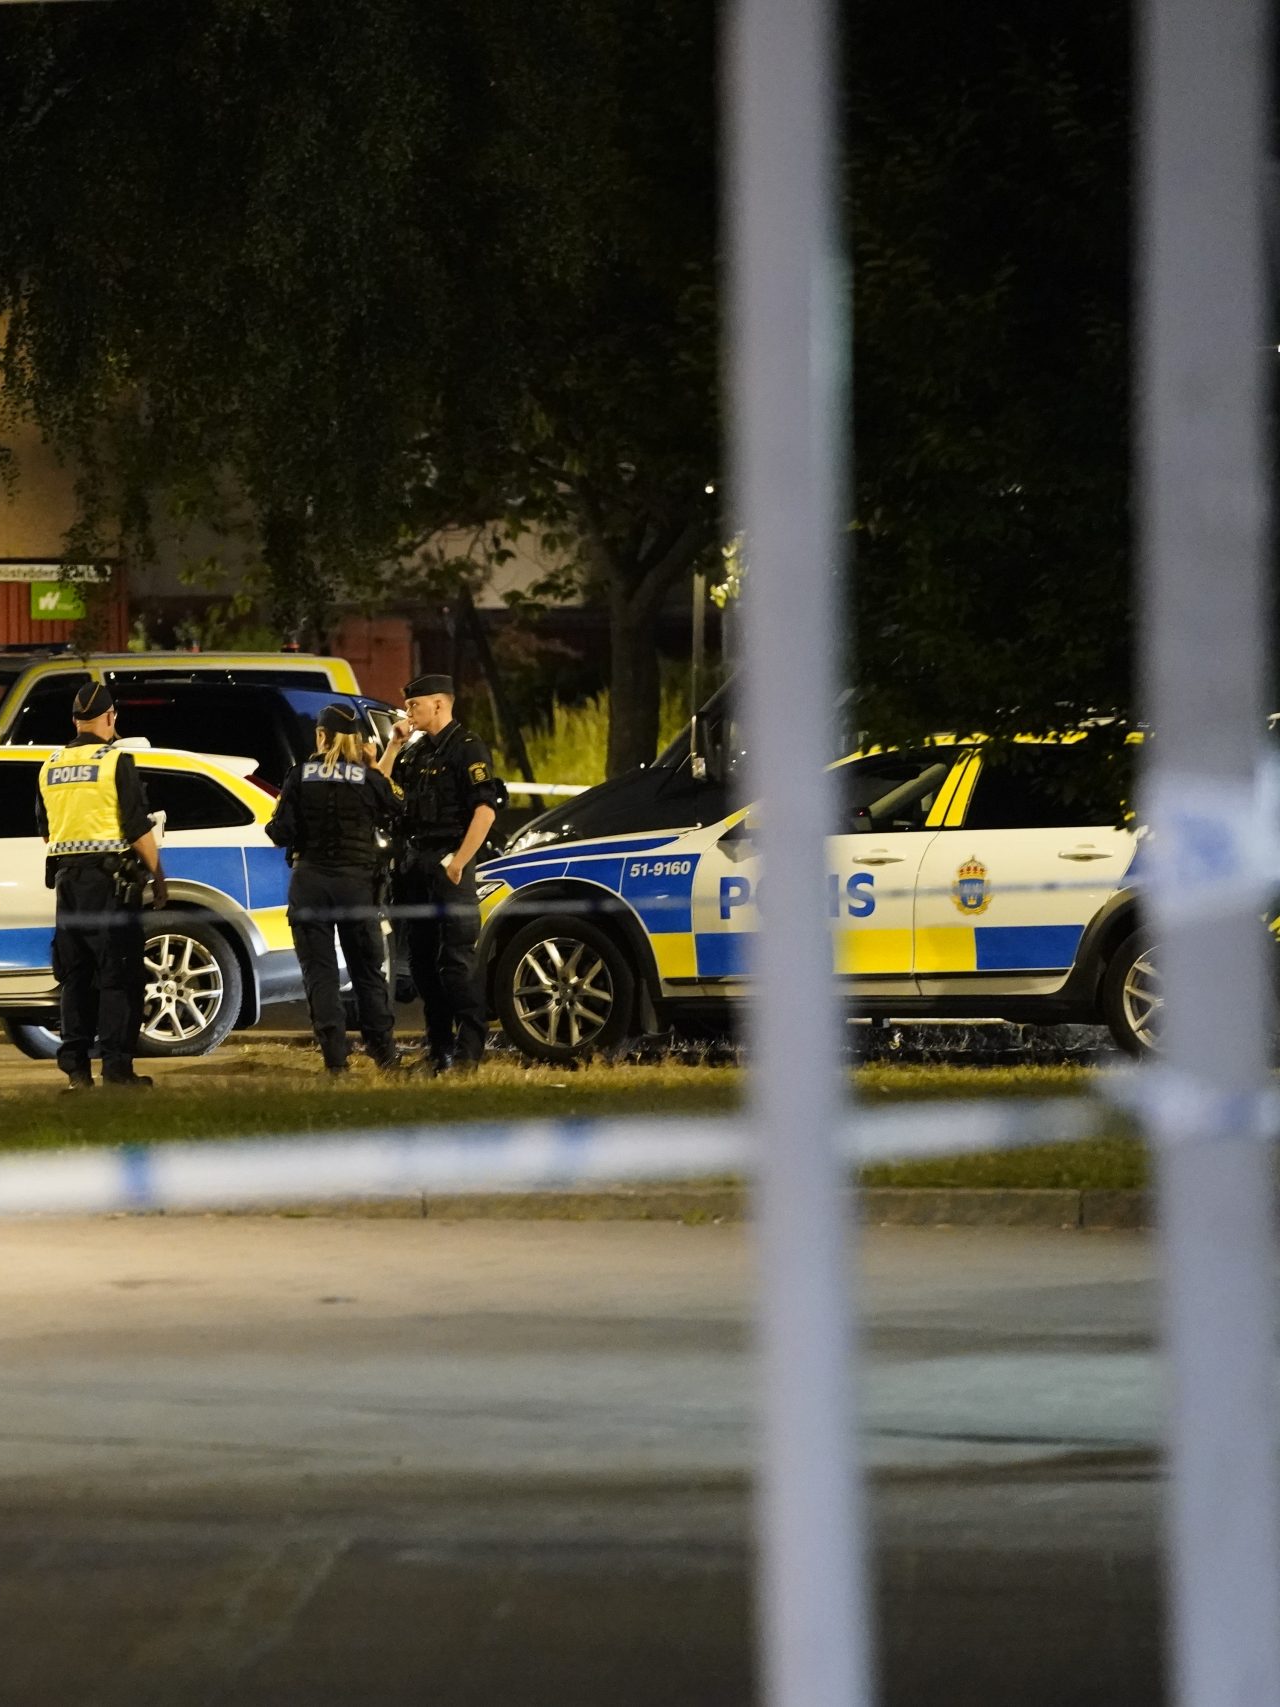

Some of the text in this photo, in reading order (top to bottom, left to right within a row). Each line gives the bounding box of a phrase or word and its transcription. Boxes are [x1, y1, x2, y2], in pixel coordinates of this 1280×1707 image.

[52, 766, 92, 783] POLIS
[304, 764, 364, 781] POLIS
[630, 860, 692, 877] 51-9160
[720, 872, 876, 920] PIS
